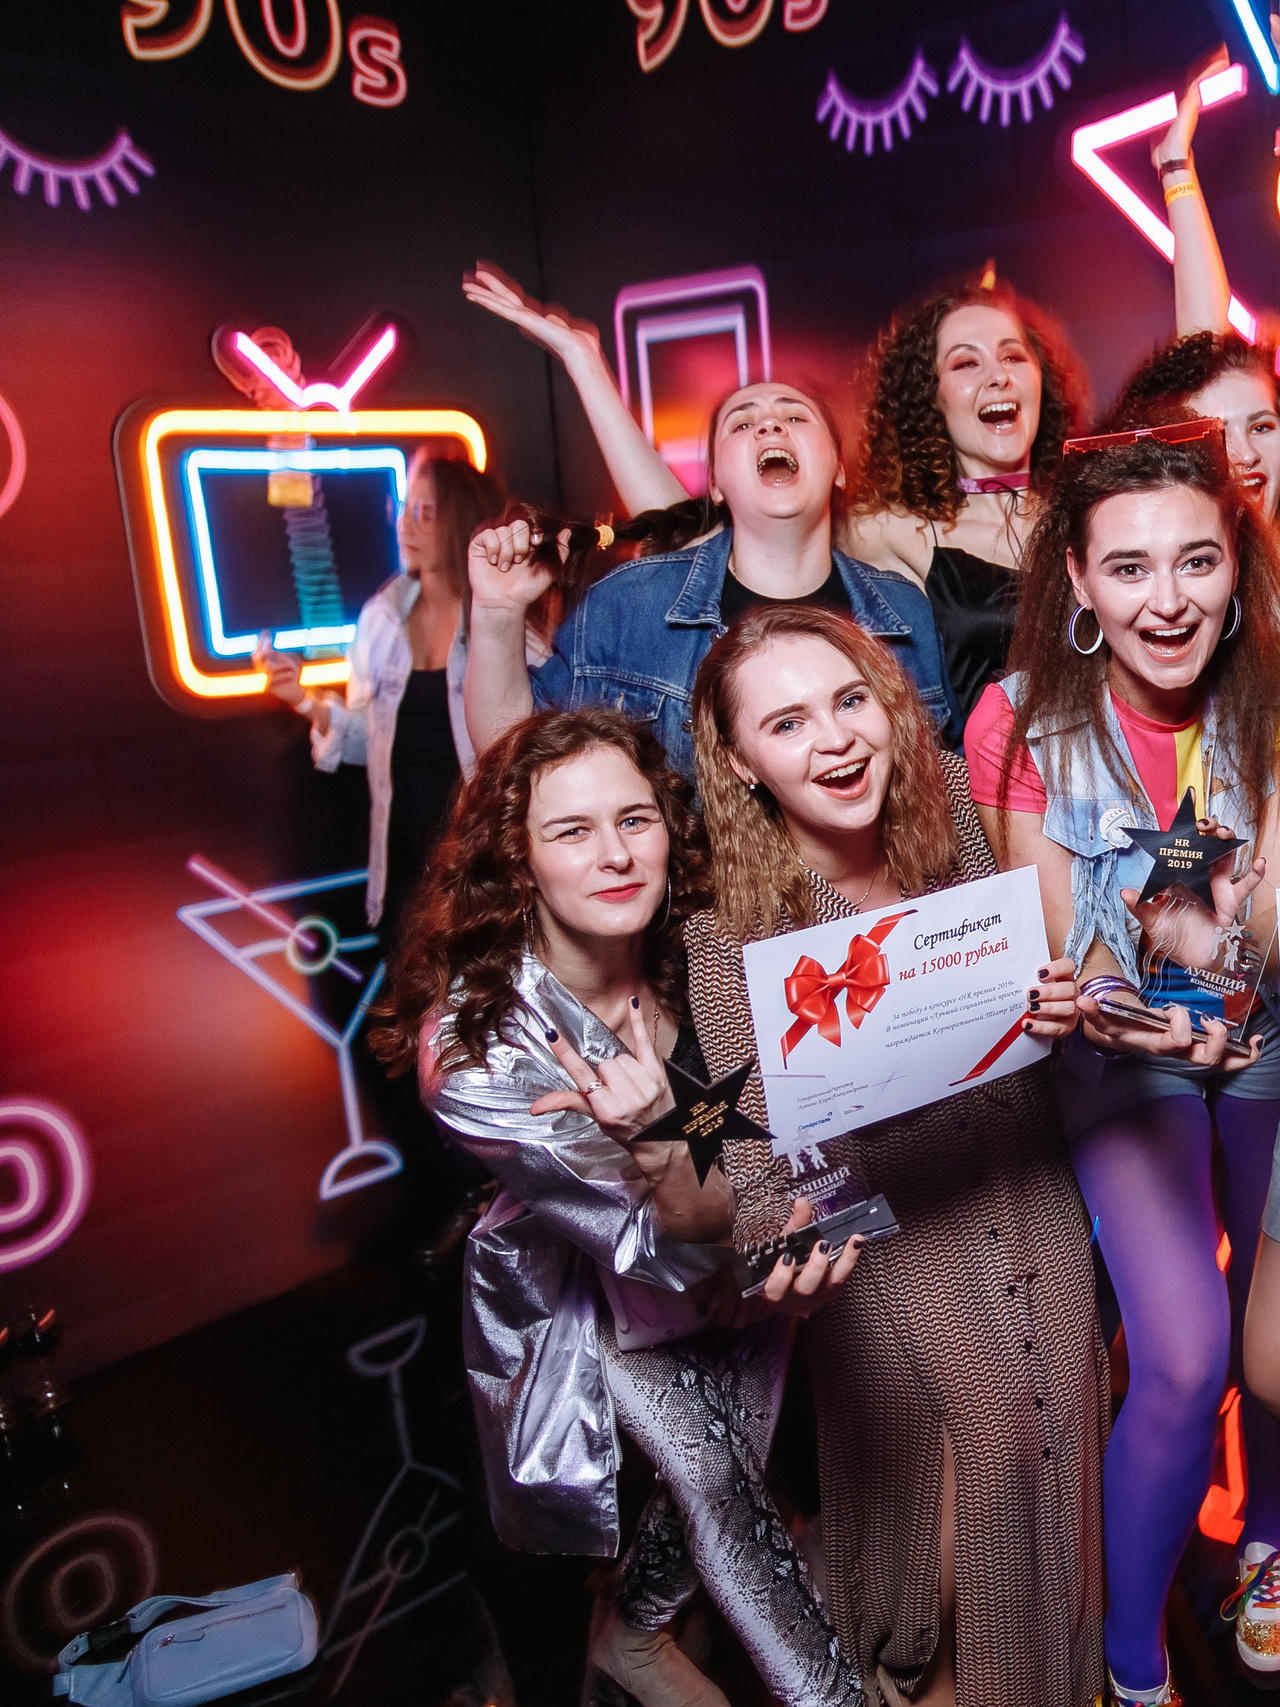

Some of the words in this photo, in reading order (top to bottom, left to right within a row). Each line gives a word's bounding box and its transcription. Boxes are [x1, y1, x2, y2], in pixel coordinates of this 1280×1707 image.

[1159, 847, 1203, 860] ПРЕМИЯ
[1174, 838, 1190, 847] HR
[1167, 859, 1192, 869] 2019
[913, 913, 1002, 950] Сертификат
[898, 967, 916, 981] на
[920, 951, 962, 976] 15000
[964, 937, 1009, 967] рублей
[1184, 965, 1247, 993] ЛУЧШИЙ
[1190, 977, 1235, 996] КОМАНДНЫЙ
[892, 1013, 901, 1022] За
[901, 1006, 923, 1018] победу
[929, 997, 957, 1010] конкурсе
[973, 986, 996, 999] премия
[997, 980, 1015, 990] 2019»
[1197, 986, 1224, 1000] ПРОЕКТ
[892, 1016, 929, 1031] номинации
[959, 995, 997, 1012] социальный
[997, 989, 1023, 1001] проект»
[885, 1031, 931, 1048] награждается
[932, 1014, 984, 1034] Корпоративный
[984, 1008, 1008, 1020] Театр
[682, 1100, 729, 1134] ПРЕМИЯ
[690, 1101, 709, 1116] HR
[699, 1116, 725, 1137] 2019
[798, 1117, 832, 1130] Северсталь
[786, 1166, 851, 1201] ЛУЧШИЙ
